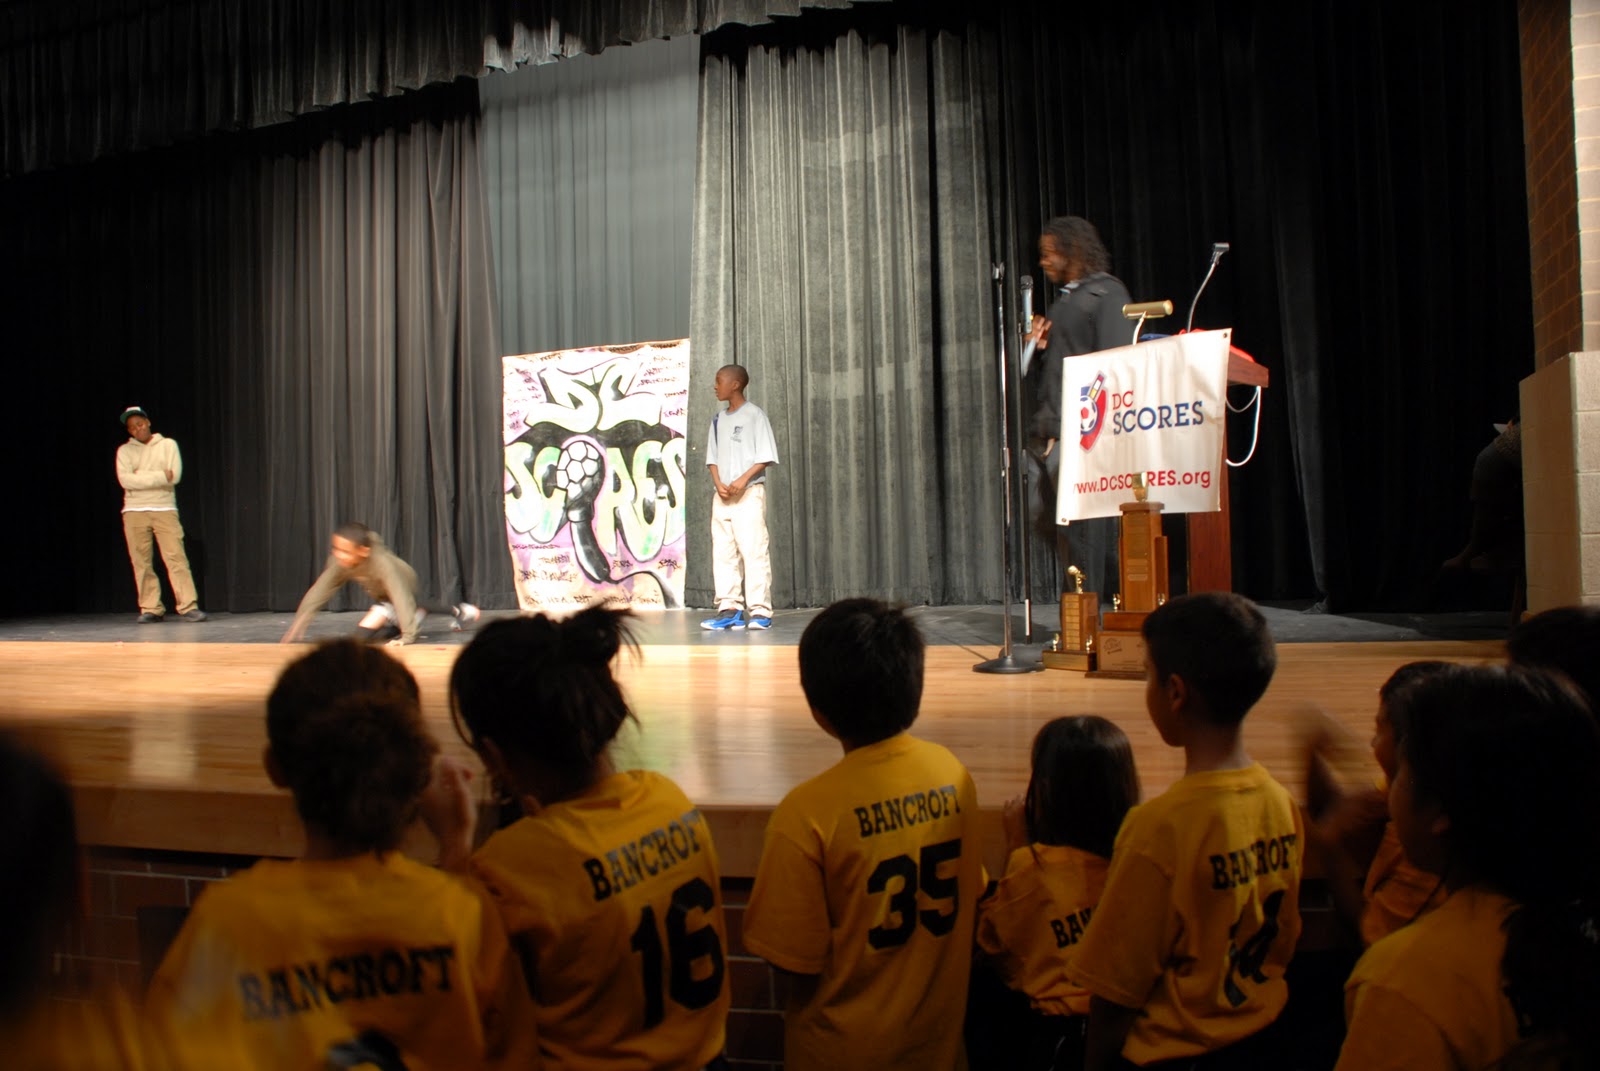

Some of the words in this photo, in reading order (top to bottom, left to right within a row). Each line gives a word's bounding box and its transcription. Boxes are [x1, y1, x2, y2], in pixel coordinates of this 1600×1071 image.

[1112, 390, 1134, 410] DC
[1112, 400, 1205, 435] SCORES
[1073, 470, 1211, 494] ww.DCSCRES.org
[854, 784, 961, 838] BANCROFT
[583, 808, 703, 902] BANCROF
[867, 838, 963, 949] 35
[238, 943, 455, 1021] BANCROFT
[631, 877, 725, 1029] 16
